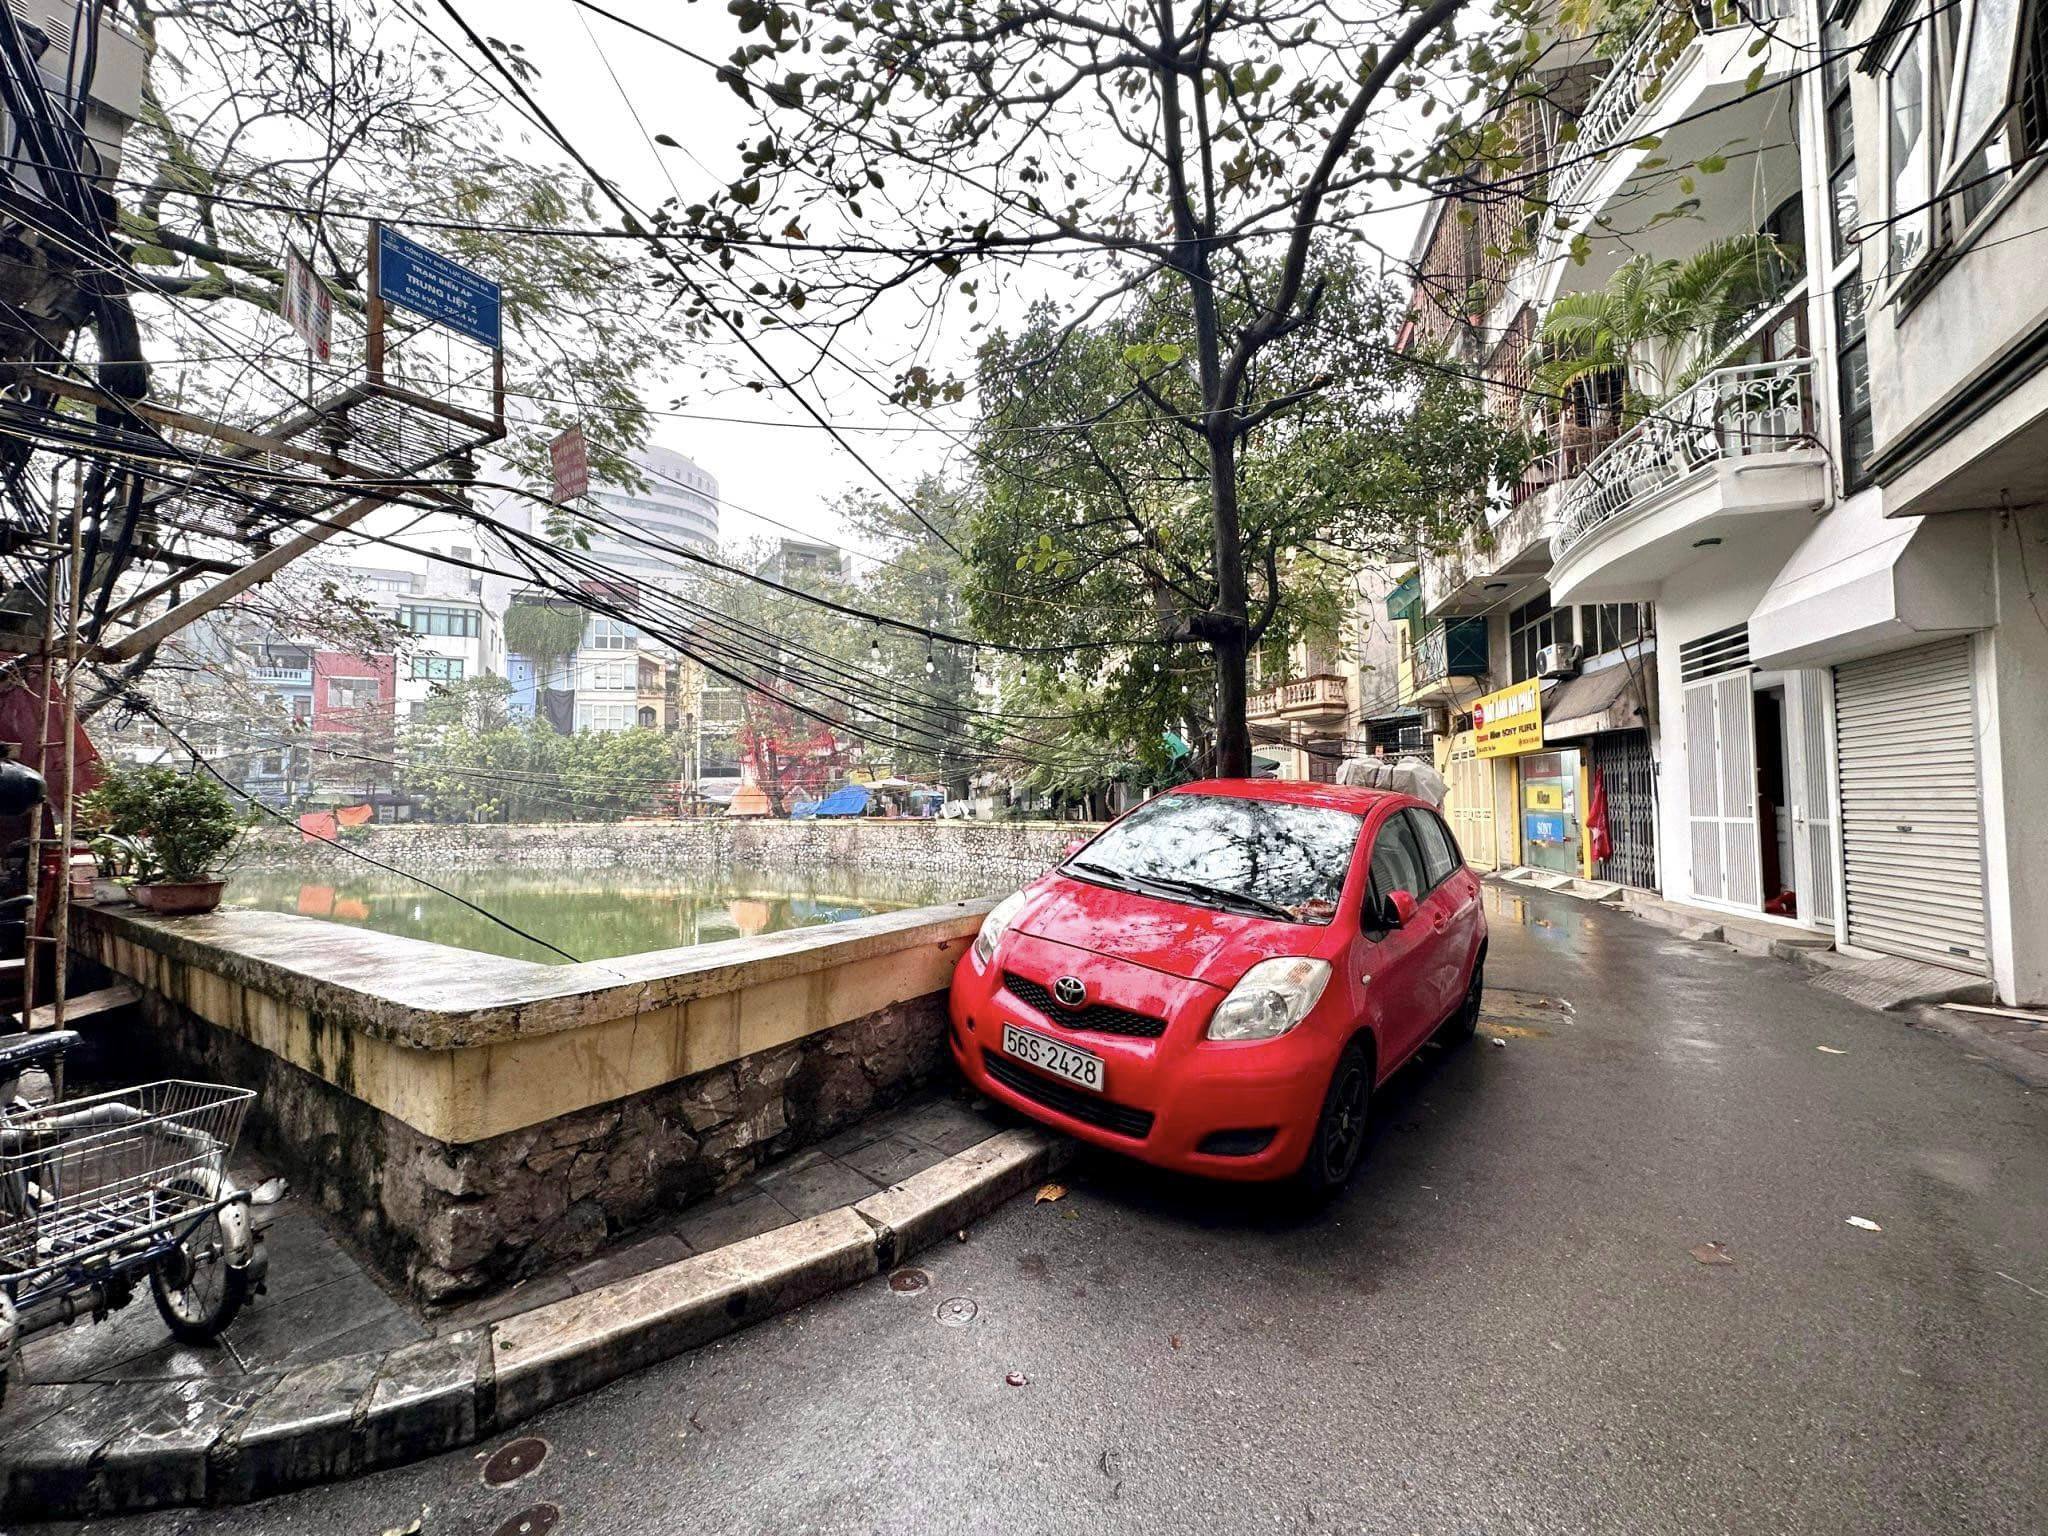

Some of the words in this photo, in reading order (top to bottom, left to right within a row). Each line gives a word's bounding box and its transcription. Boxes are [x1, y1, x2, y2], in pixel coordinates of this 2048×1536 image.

[404, 245, 423, 260] CÔNG
[425, 256, 433, 264] TY
[406, 273, 444, 299] TRUNG
[447, 292, 469, 311] LIỆT
[471, 305, 477, 314] 2
[405, 287, 420, 298] 630
[422, 295, 438, 307] kVA
[467, 316, 478, 325] kV
[1502, 727, 1517, 737] SONY
[1537, 822, 1553, 835] SONY
